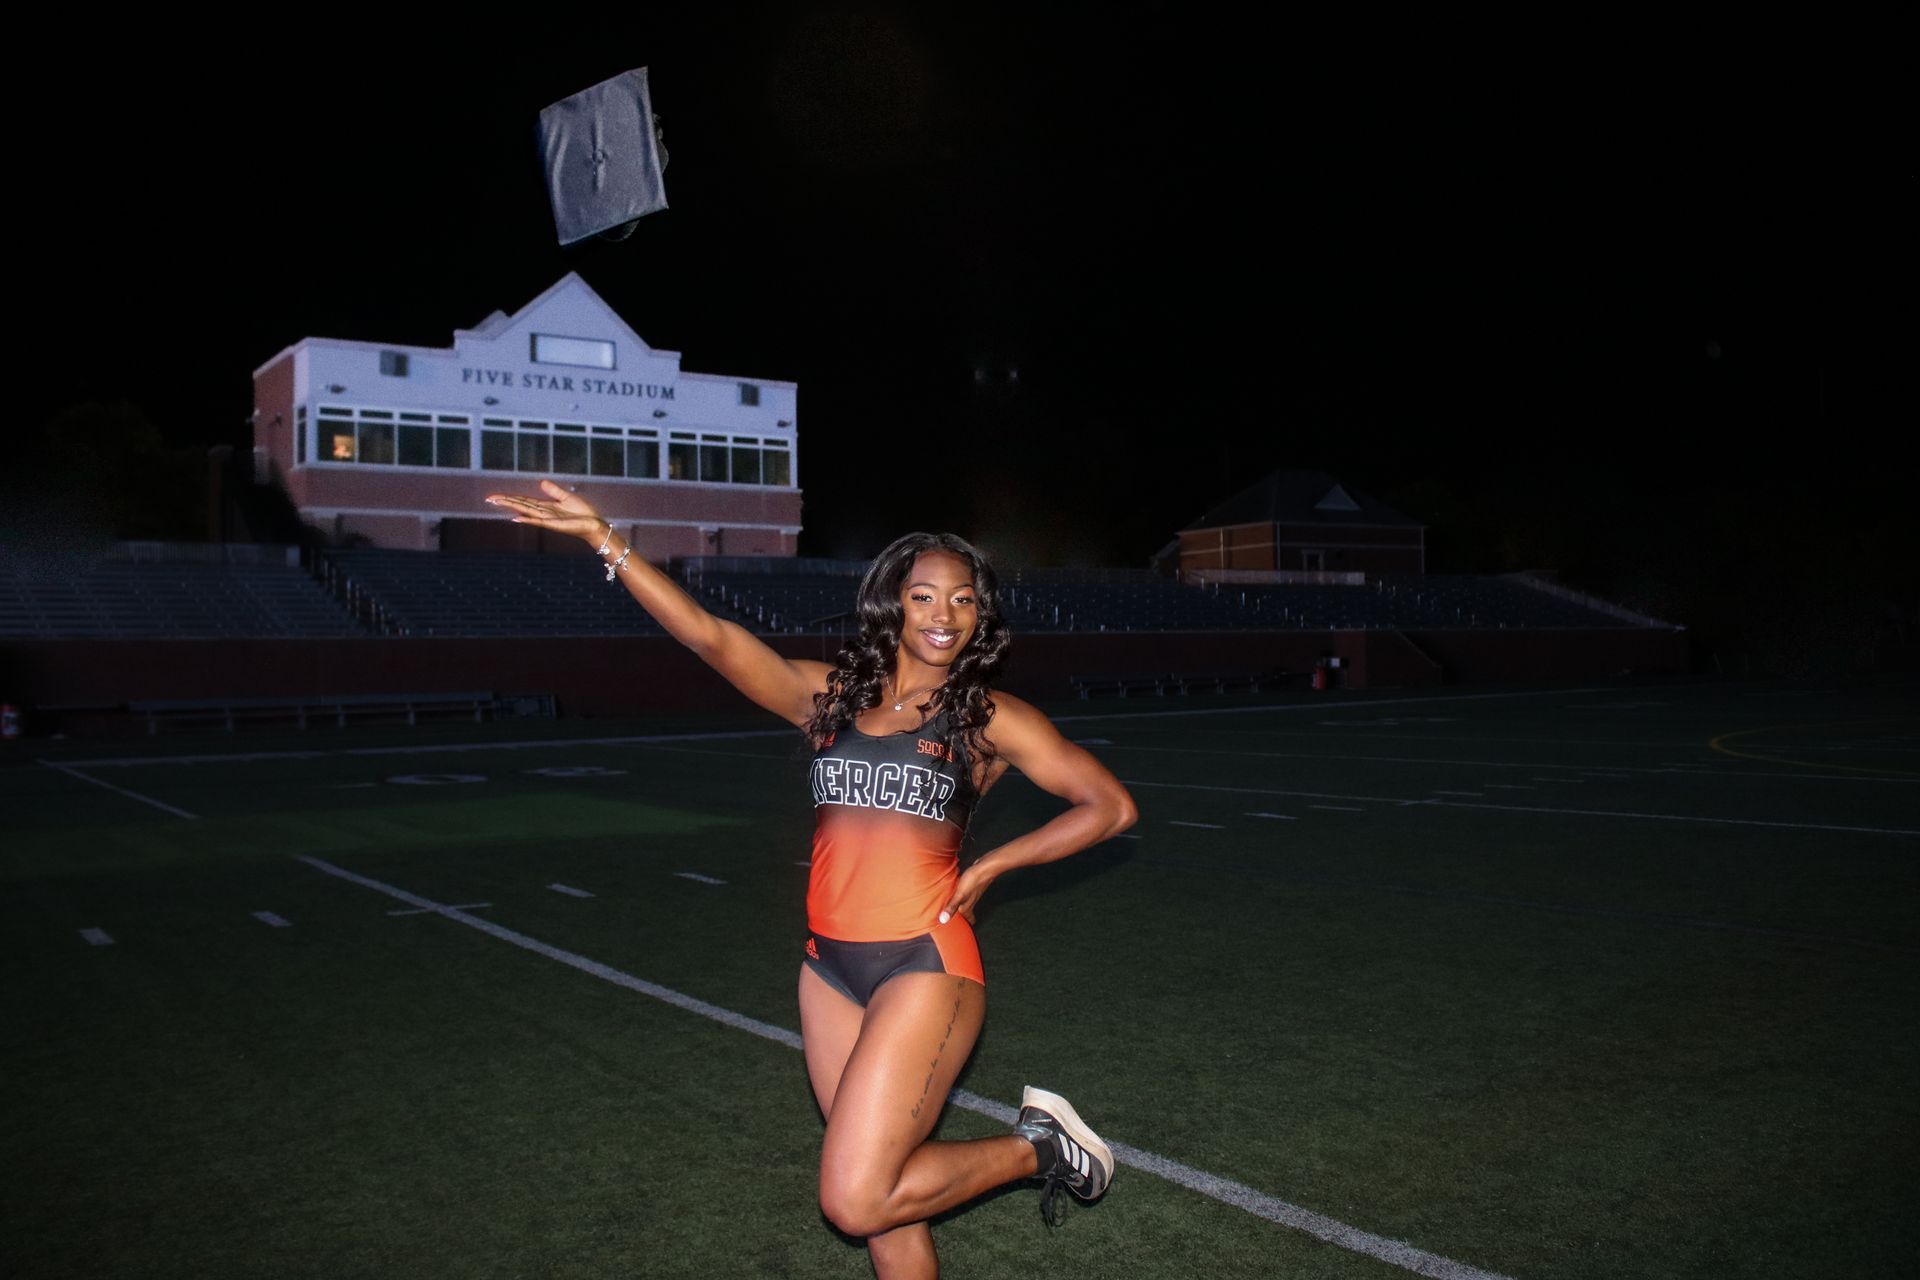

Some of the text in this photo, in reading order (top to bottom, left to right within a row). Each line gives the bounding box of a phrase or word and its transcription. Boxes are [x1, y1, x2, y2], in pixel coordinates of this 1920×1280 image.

[461, 367, 676, 400] FIVE STAR STADIUM
[917, 738, 953, 763] SOCC
